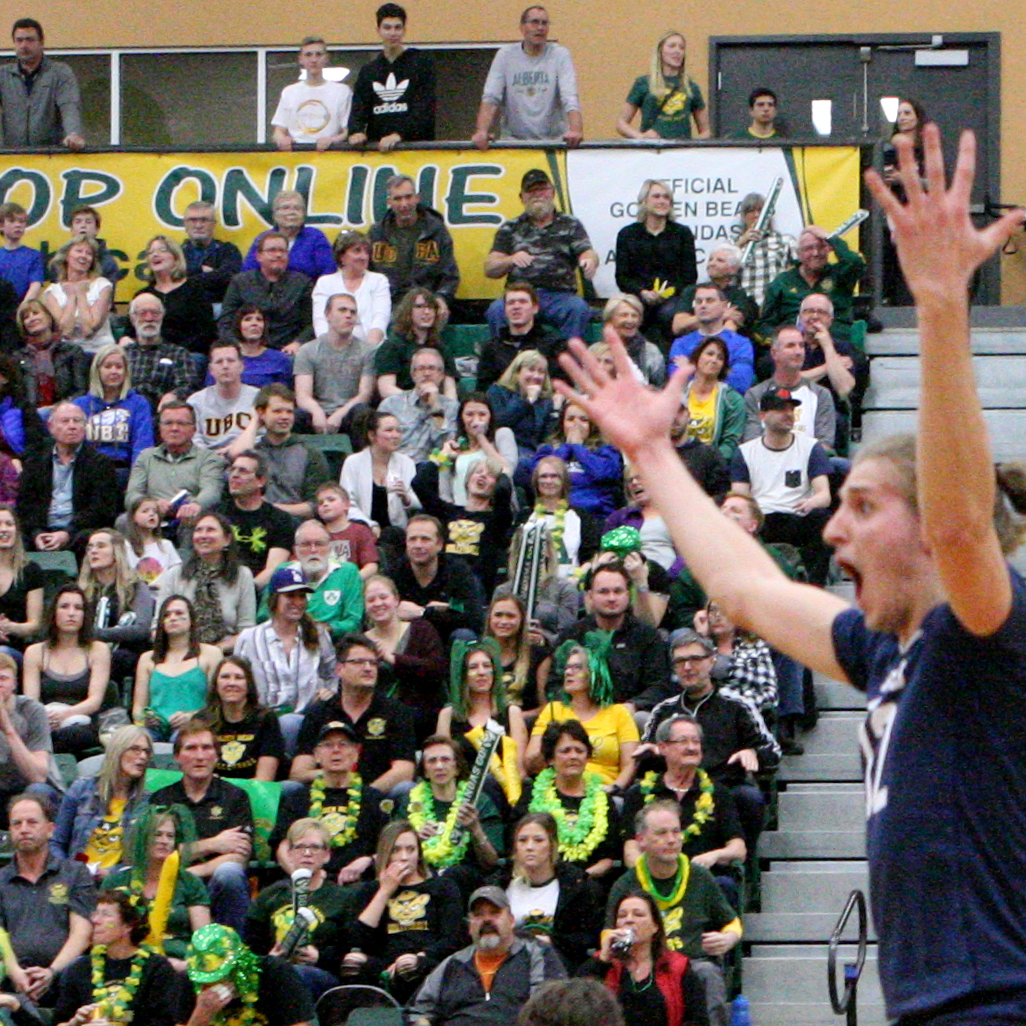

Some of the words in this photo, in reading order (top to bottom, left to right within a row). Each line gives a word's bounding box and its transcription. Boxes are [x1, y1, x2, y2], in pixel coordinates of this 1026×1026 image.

[373, 102, 408, 115] adidas
[153, 164, 507, 231] ONLINE
[206, 411, 252, 437] UBC
